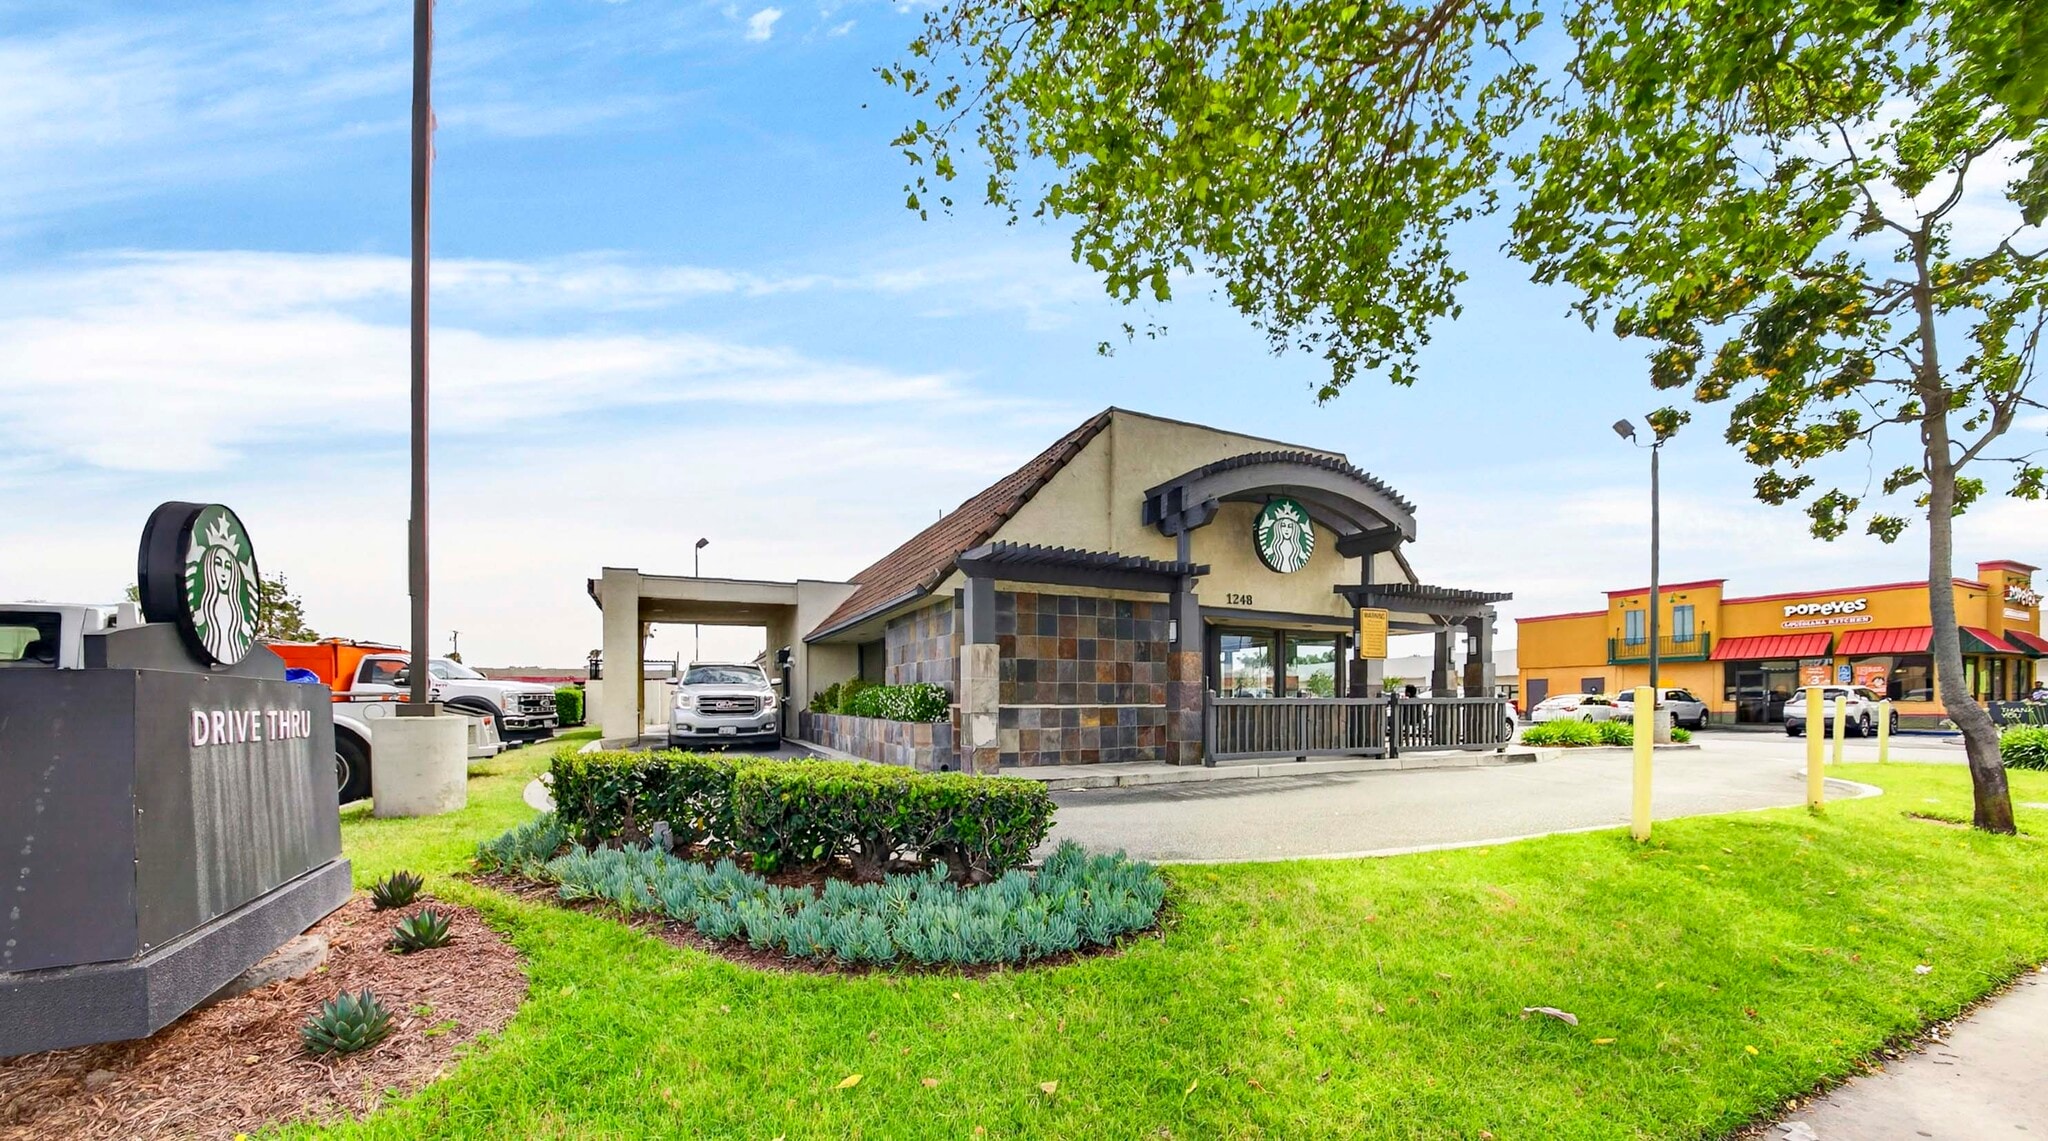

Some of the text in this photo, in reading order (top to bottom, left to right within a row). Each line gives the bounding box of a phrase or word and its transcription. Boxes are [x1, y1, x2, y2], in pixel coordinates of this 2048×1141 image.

[1226, 593, 1253, 605] 1248
[1829, 616, 1869, 624] KITCHEN
[192, 710, 310, 747] DRIVE THRU
